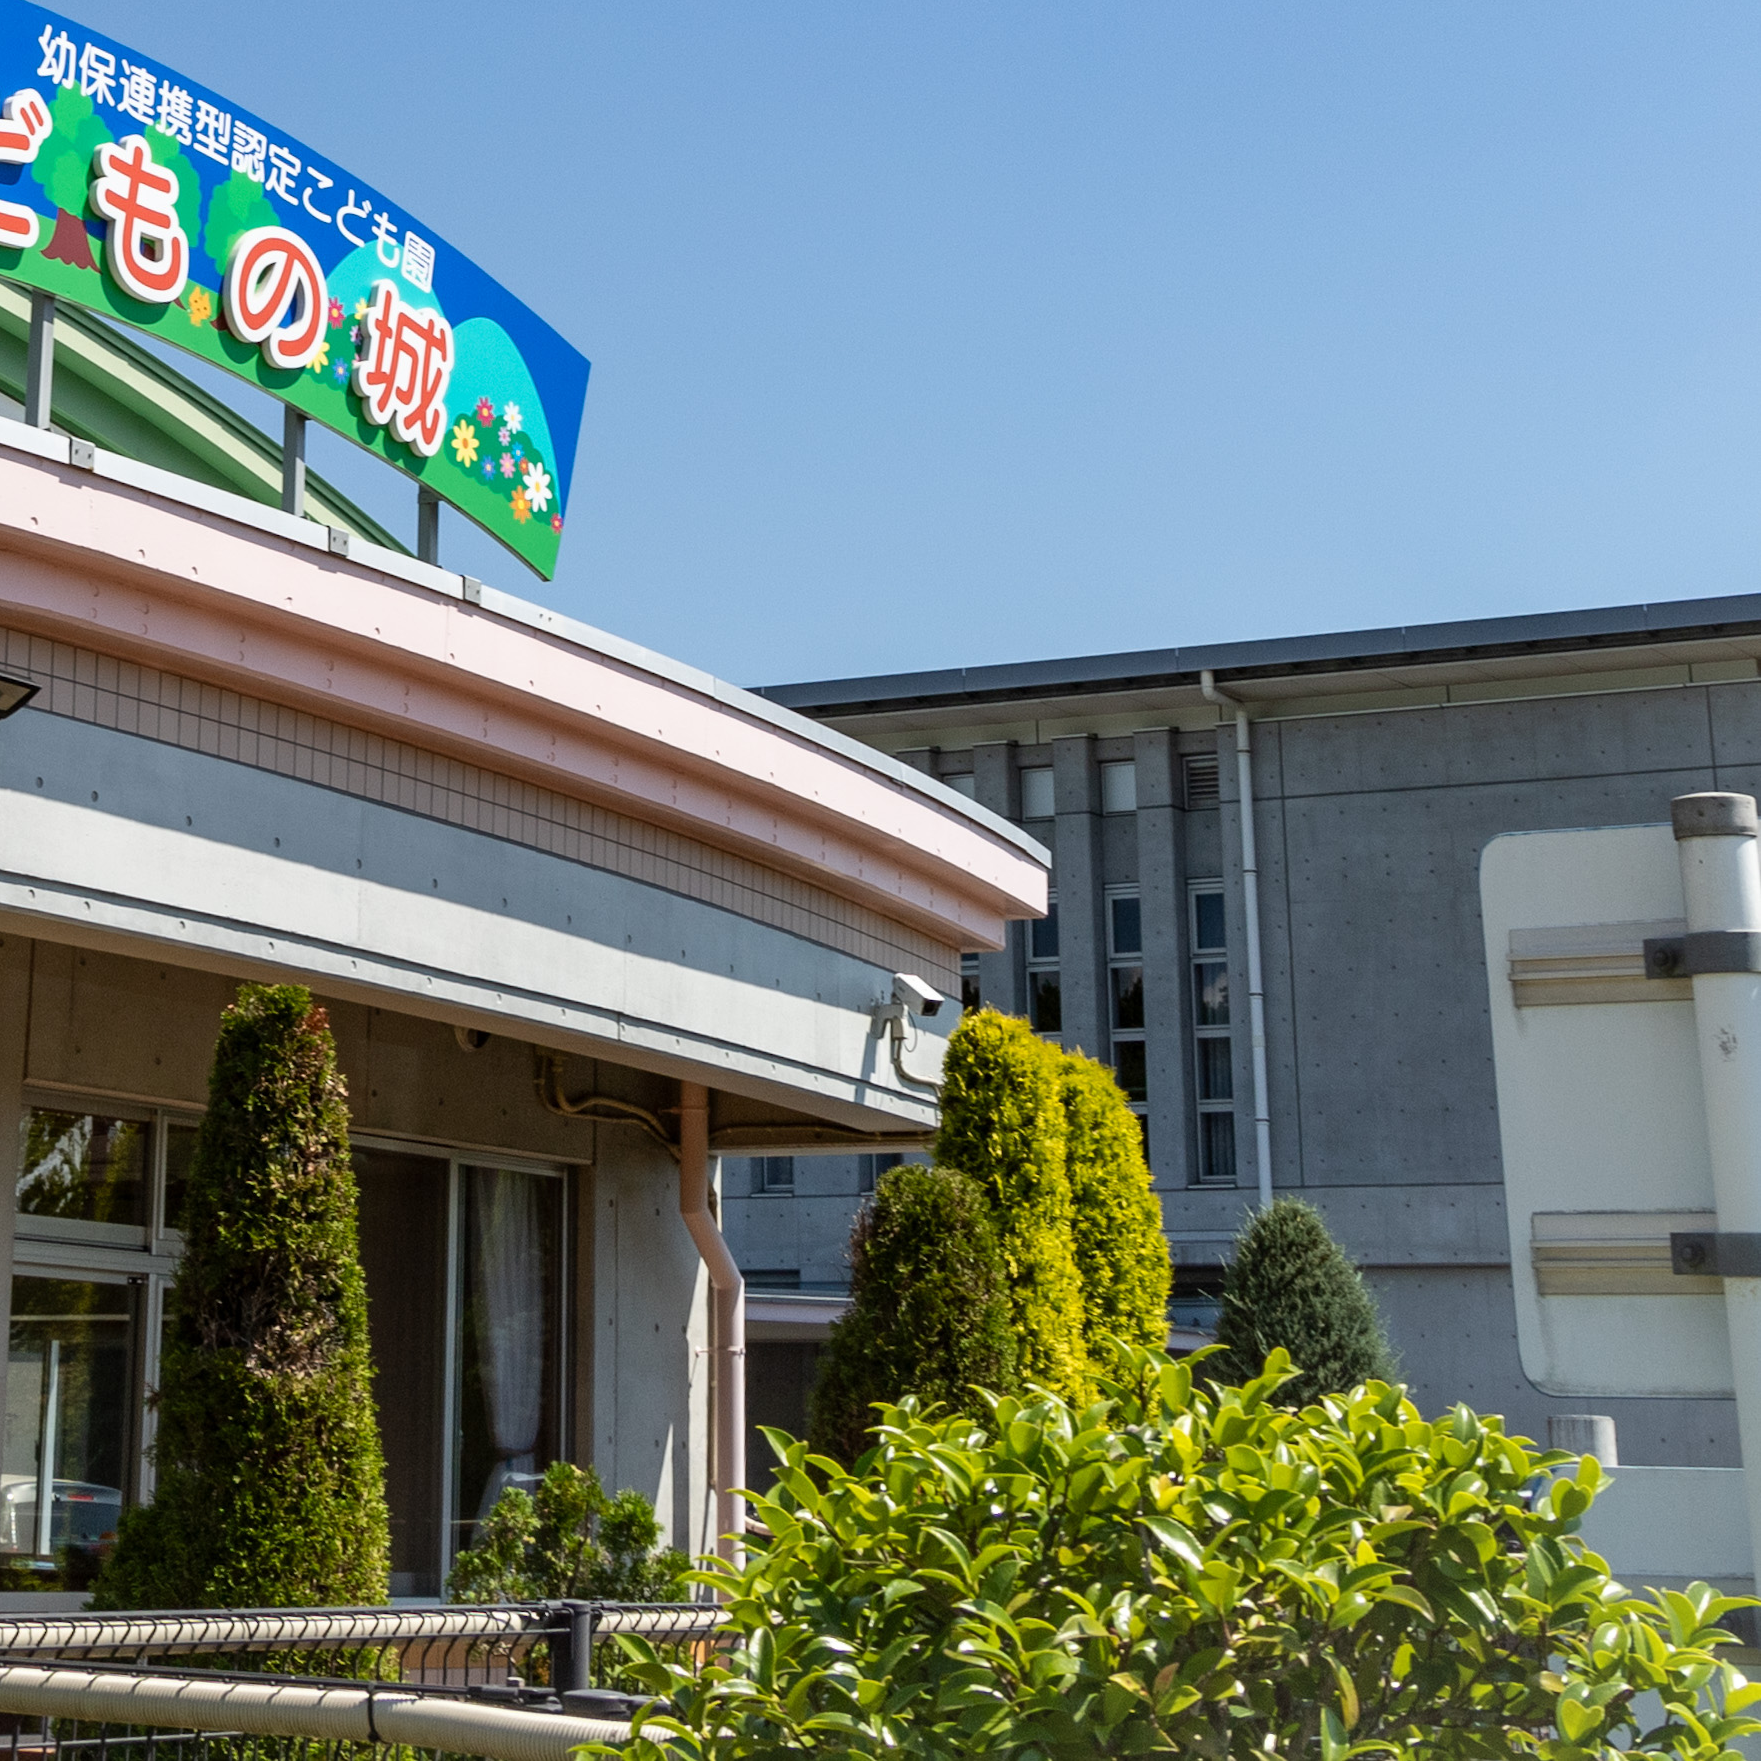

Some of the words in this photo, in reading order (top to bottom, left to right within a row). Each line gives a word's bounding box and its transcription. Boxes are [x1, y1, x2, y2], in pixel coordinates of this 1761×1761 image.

[37, 24, 435, 292] 幼保連携型認定こども園
